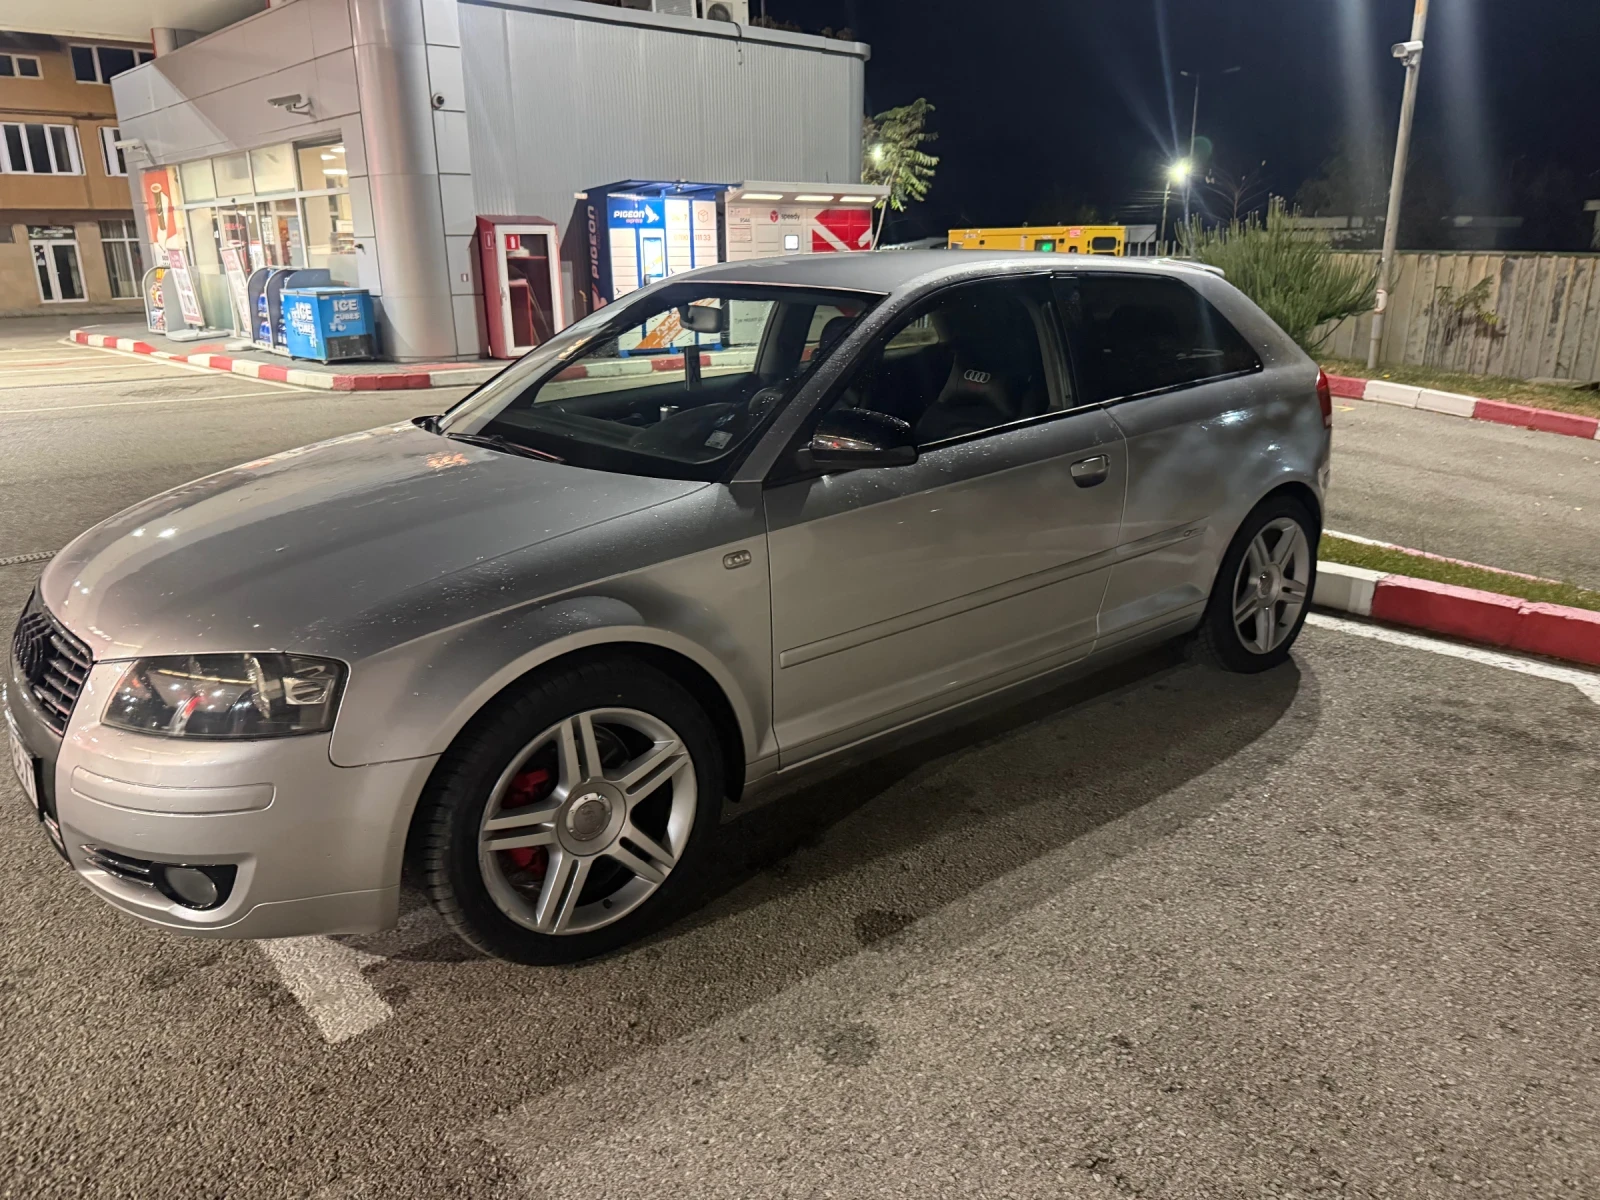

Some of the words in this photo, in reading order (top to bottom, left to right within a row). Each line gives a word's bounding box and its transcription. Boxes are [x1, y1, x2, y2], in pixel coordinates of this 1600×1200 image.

[613, 210, 645, 218] PIGEON
[781, 213, 800, 221] speedy
[588, 206, 600, 279] PIGEON
[333, 300, 357, 312] ICE
[296, 302, 312, 321] ICE
[335, 313, 360, 321] CUBES
